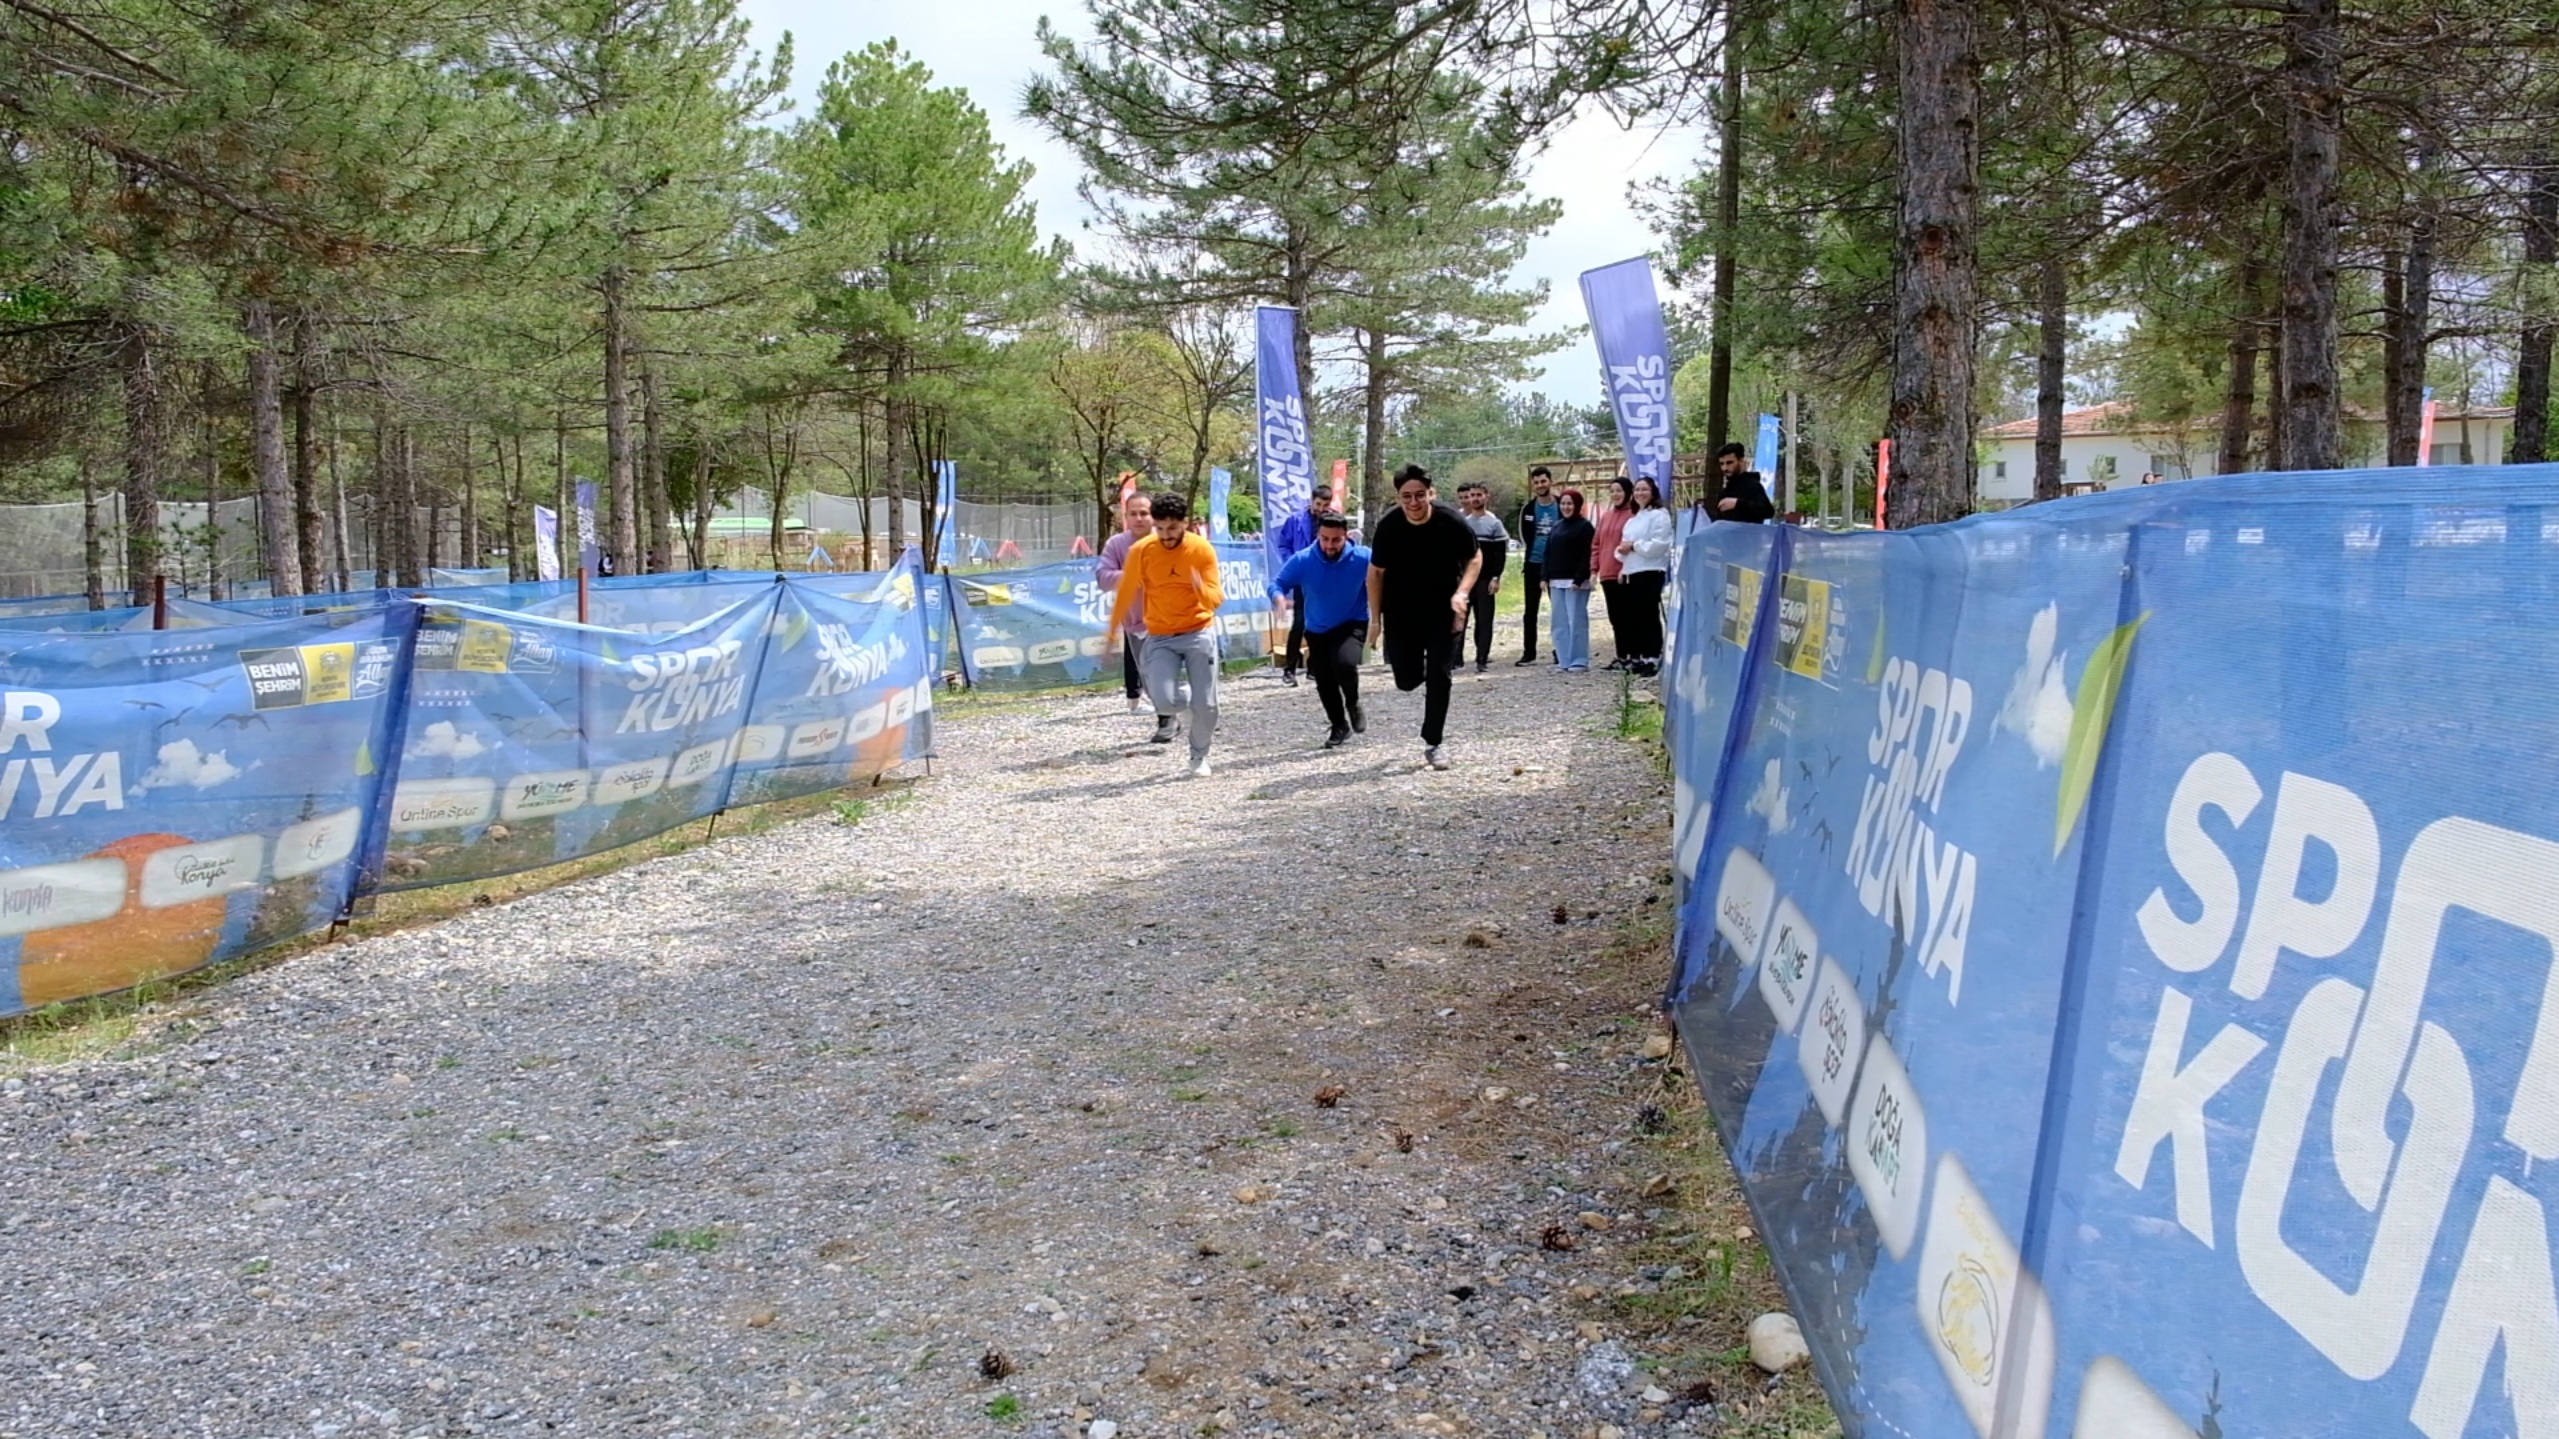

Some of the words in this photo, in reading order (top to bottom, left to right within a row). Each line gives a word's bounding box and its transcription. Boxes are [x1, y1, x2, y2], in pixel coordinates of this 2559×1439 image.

[1285, 394, 1314, 502] SPOR
[1609, 364, 1659, 480] KONY
[1637, 354, 1672, 463] SPOR
[1265, 397, 1292, 530] KONYA
[615, 674, 746, 734] KONYA
[627, 640, 742, 697] SPOR
[1867, 655, 1973, 820] SPOR
[1844, 750, 1978, 1009] KONYA
[1875, 1082, 1904, 1158] DOĞA
